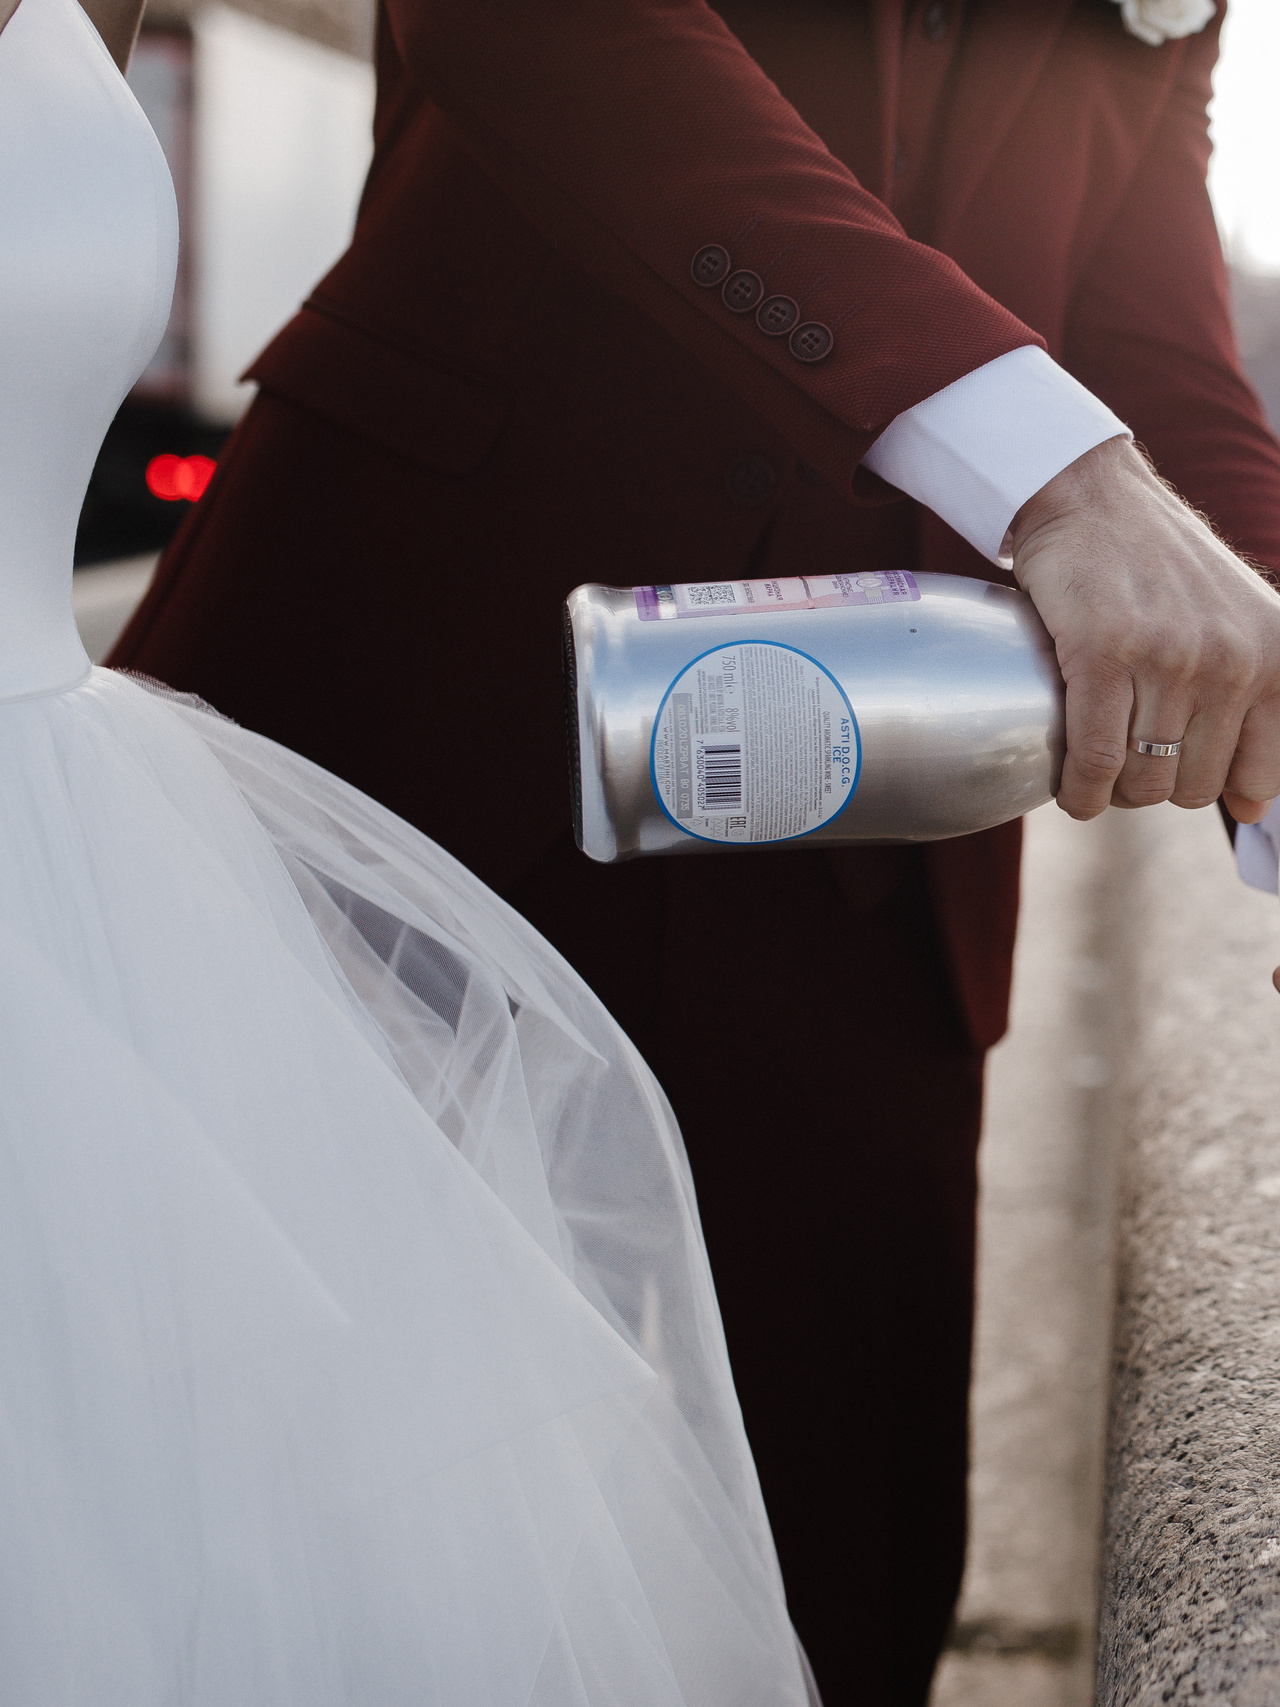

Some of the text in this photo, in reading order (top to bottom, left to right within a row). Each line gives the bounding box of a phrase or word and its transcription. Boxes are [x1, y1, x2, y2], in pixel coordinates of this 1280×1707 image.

[722, 656, 736, 671] 750
[823, 711, 831, 728] QUALITY
[663, 727, 671, 795] WWW.MARTINI.COM
[824, 750, 832, 771] SPARKLING
[833, 746, 841, 764] ICE
[841, 718, 851, 787] ASTI D.O.C.G.
[697, 750, 705, 780] 630040
[697, 783, 705, 808] 405027
[824, 783, 832, 794] SWEET
